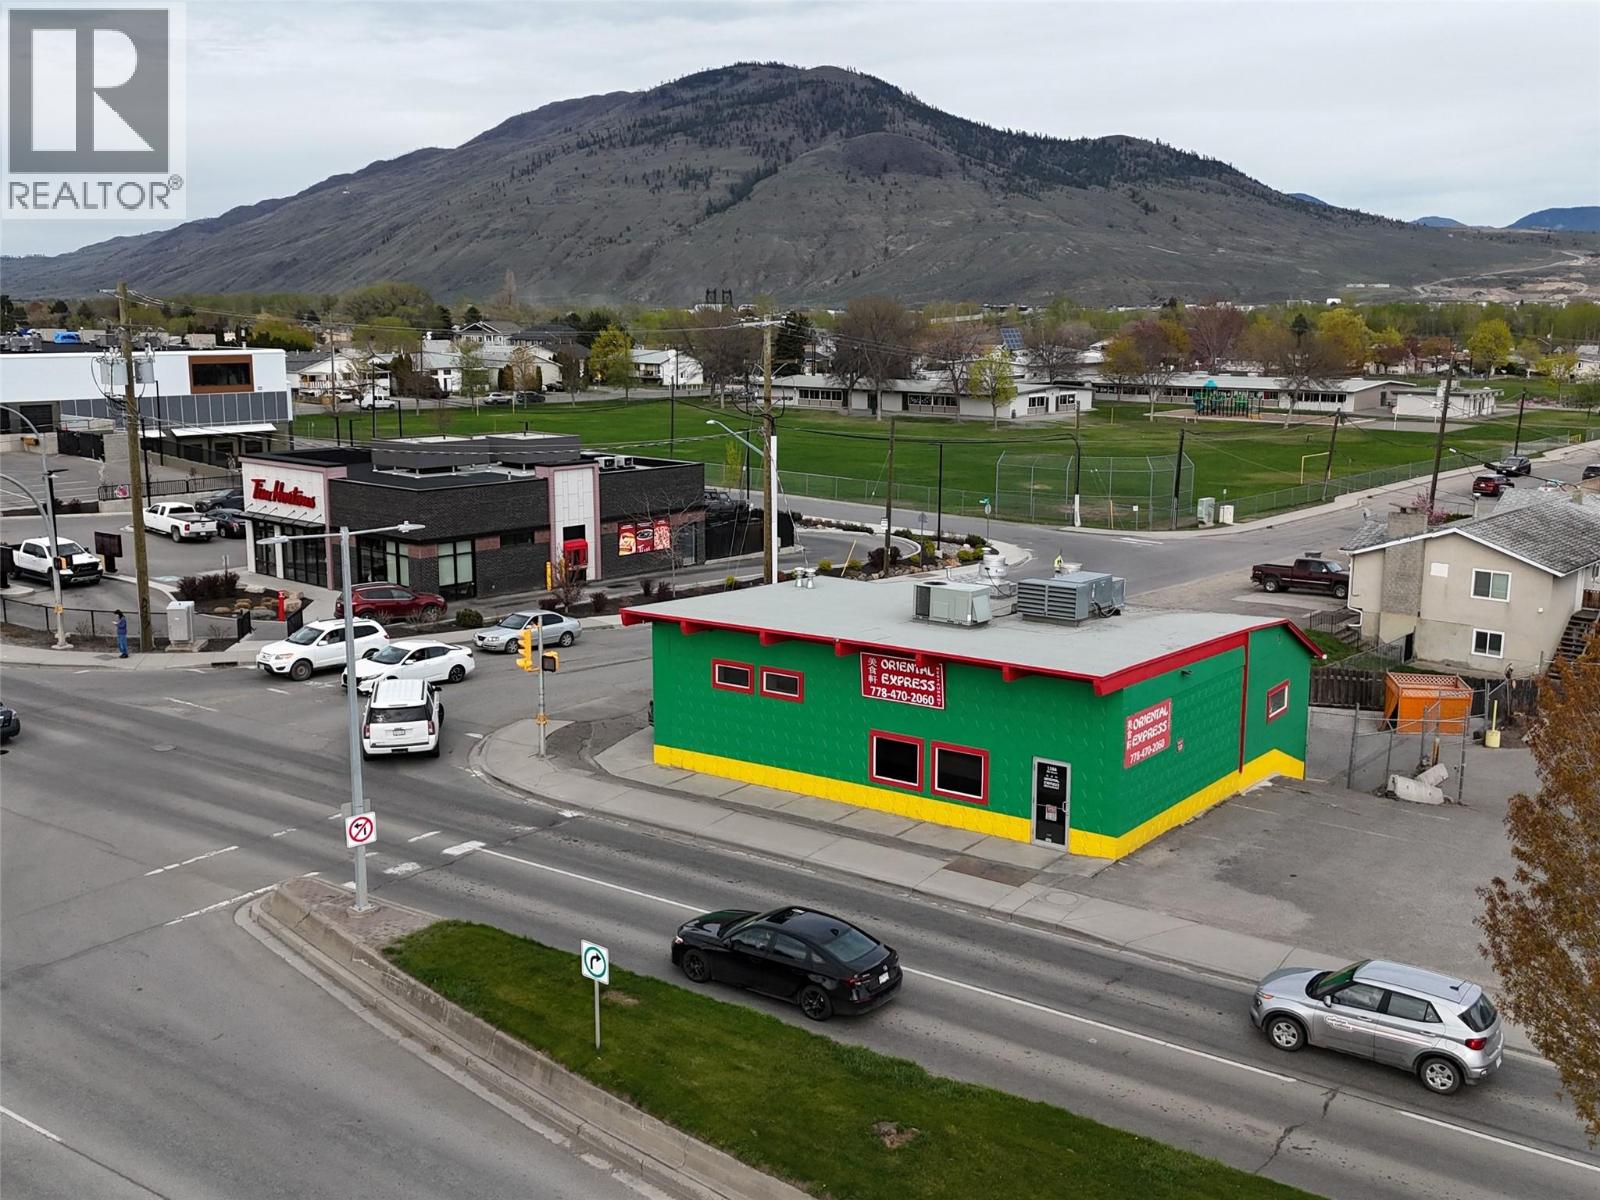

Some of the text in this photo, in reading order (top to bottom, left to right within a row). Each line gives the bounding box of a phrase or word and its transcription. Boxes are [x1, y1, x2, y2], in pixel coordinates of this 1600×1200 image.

[881, 673, 935, 691] EXPRESS
[870, 686, 934, 705] 778-470-2060
[1133, 705, 1168, 730] ORIENTAL
[1132, 720, 1167, 747] EXPRESS
